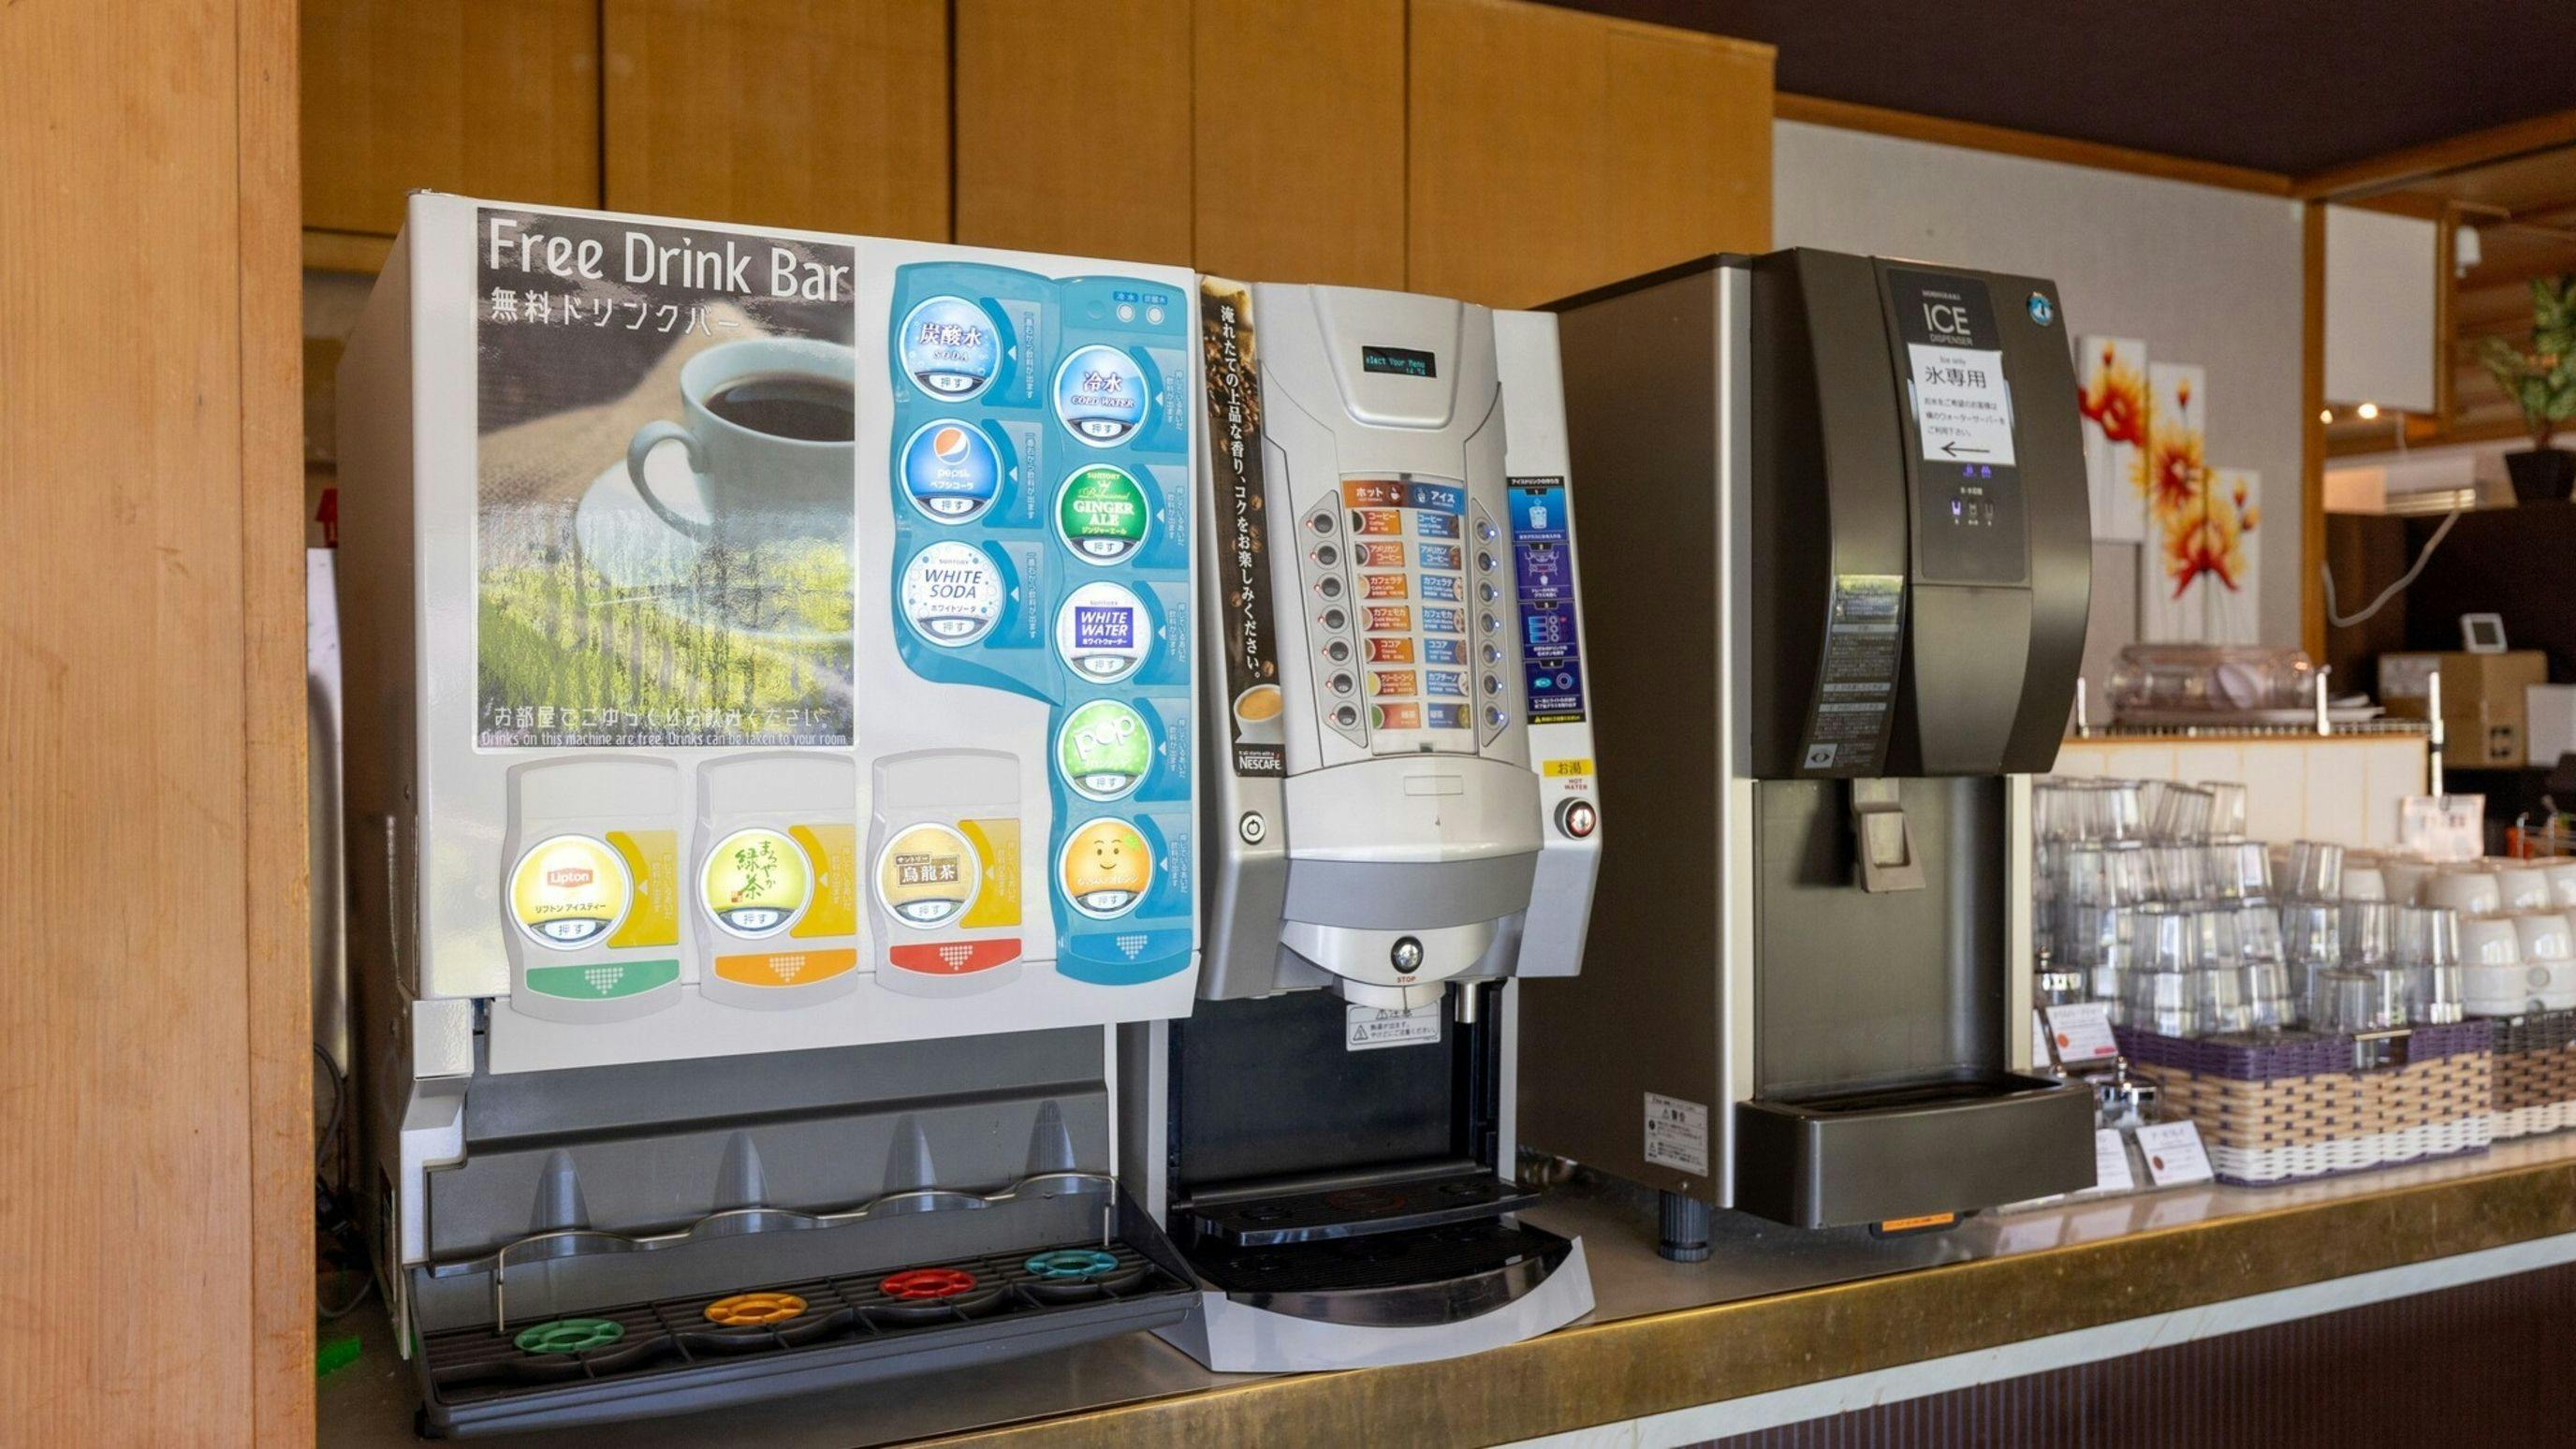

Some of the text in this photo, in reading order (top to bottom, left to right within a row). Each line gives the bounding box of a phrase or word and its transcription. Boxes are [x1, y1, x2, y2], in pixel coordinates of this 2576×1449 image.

[490, 217, 850, 301] Free Drink Bar
[490, 286, 740, 337] 無料ドリンクバー
[1924, 303, 1970, 335] ICE
[919, 324, 982, 346] 炭酸水
[1930, 334, 1972, 347] DISPENSER
[1083, 372, 1122, 393] 冷水
[1925, 366, 1986, 388] 氷専用
[1072, 396, 1135, 408] COLD WATER
[1356, 488, 1383, 497] ホット
[1431, 490, 1456, 504] アイス
[1073, 501, 1134, 515] GINGER
[1089, 514, 1120, 526] ALE
[1368, 512, 1397, 520] コーヒー
[1418, 515, 1442, 523] コーヒー
[925, 569, 983, 583] WHITE
[1423, 577, 1454, 586] カフェラテ
[929, 584, 976, 599] SODA
[1080, 611, 1128, 624] WHITE
[1424, 609, 1454, 619] カフェモカ
[1081, 623, 1129, 637] WATER
[1428, 640, 1448, 649] ココア
[480, 732, 520, 746] Drinks
[523, 734, 538, 745] on
[541, 732, 562, 745] this
[566, 733, 613, 746] machine
[616, 735, 635, 745] are
[668, 732, 702, 746] Drinks
[706, 735, 725, 745] can
[794, 734, 815, 747] your
[1558, 761, 1582, 775] お湯
[550, 872, 590, 886] Lipton
[735, 848, 765, 900] 緑茶
[901, 864, 955, 883] 烏龍茶
[565, 902, 607, 912] アイスティー
[559, 924, 584, 935] 押す
